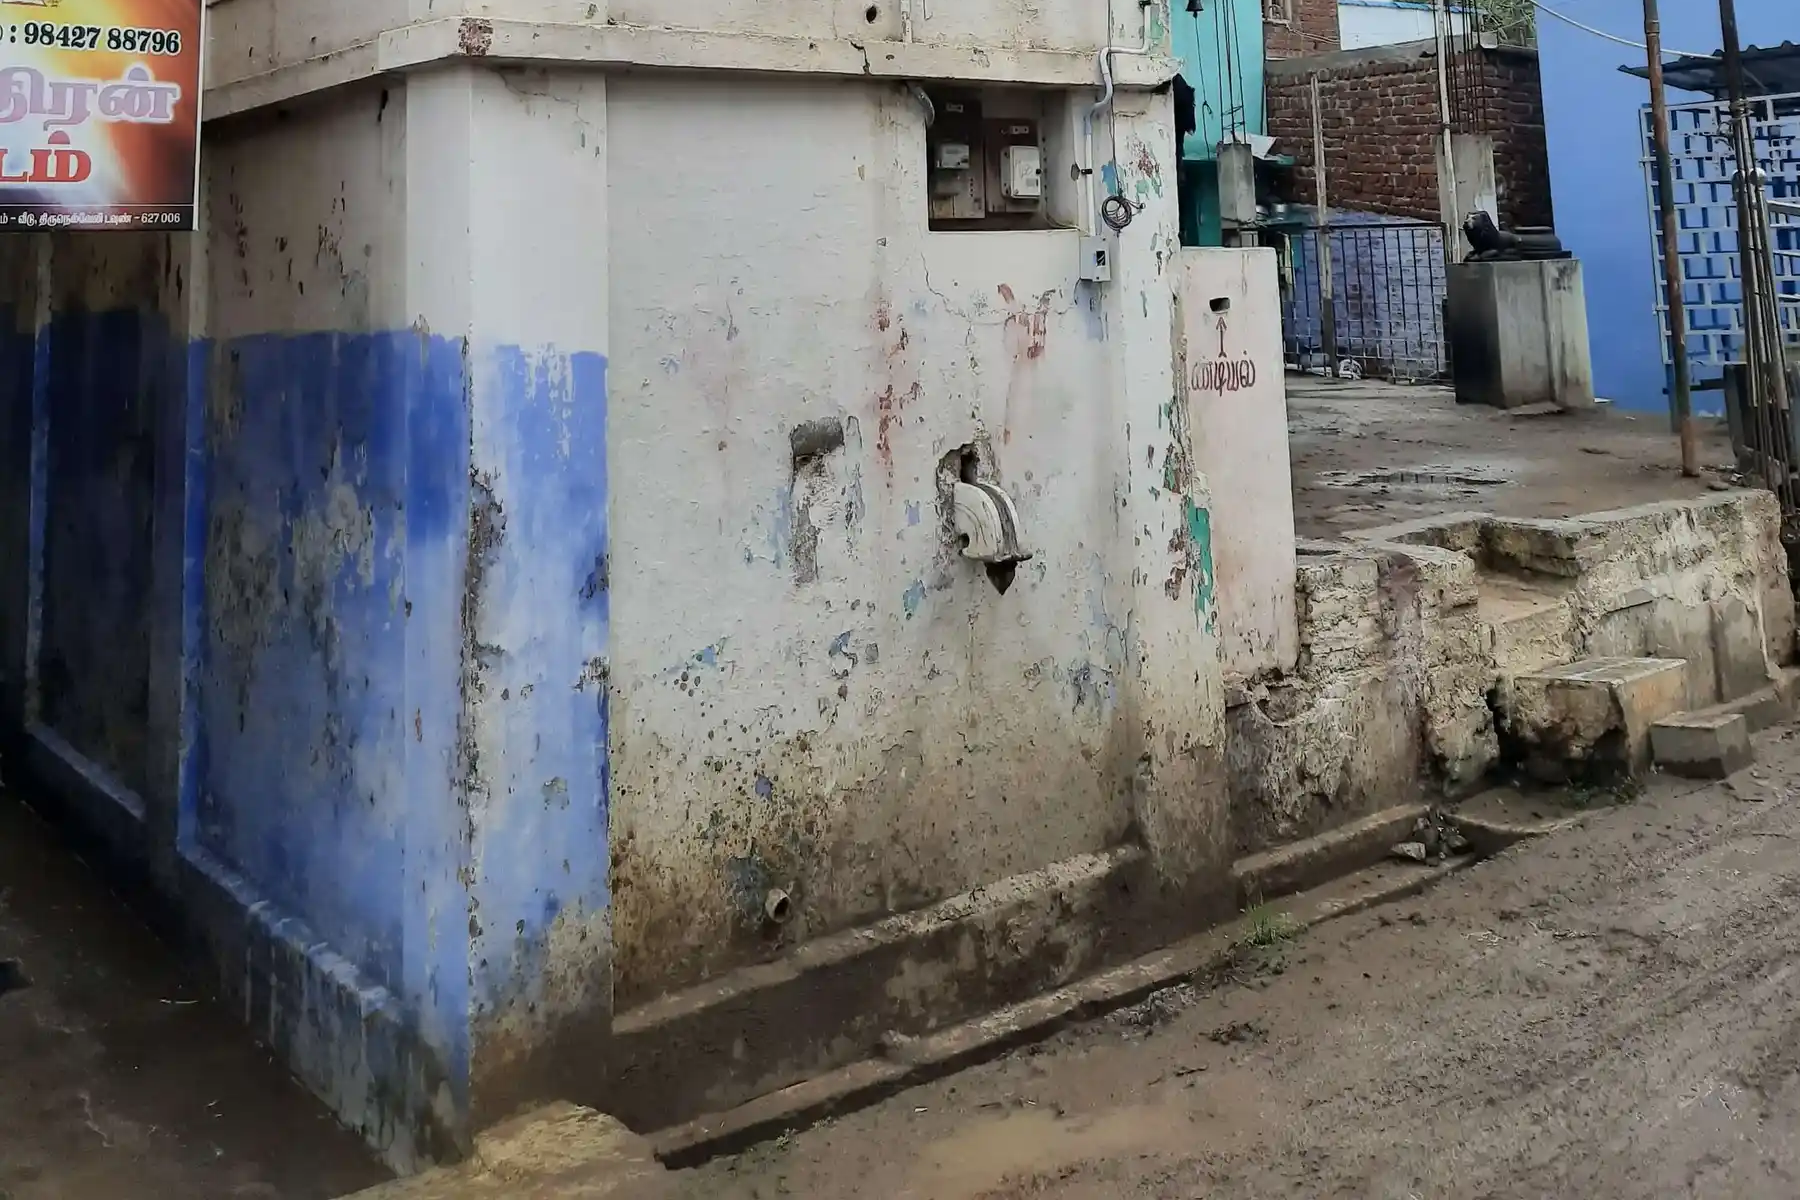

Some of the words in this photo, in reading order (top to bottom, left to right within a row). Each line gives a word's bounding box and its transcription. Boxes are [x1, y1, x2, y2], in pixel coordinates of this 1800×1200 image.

[24, 22, 101, 49] 98427
[107, 27, 180, 54] 88796
[141, 212, 160, 224] 627
[161, 212, 181, 224] 006
